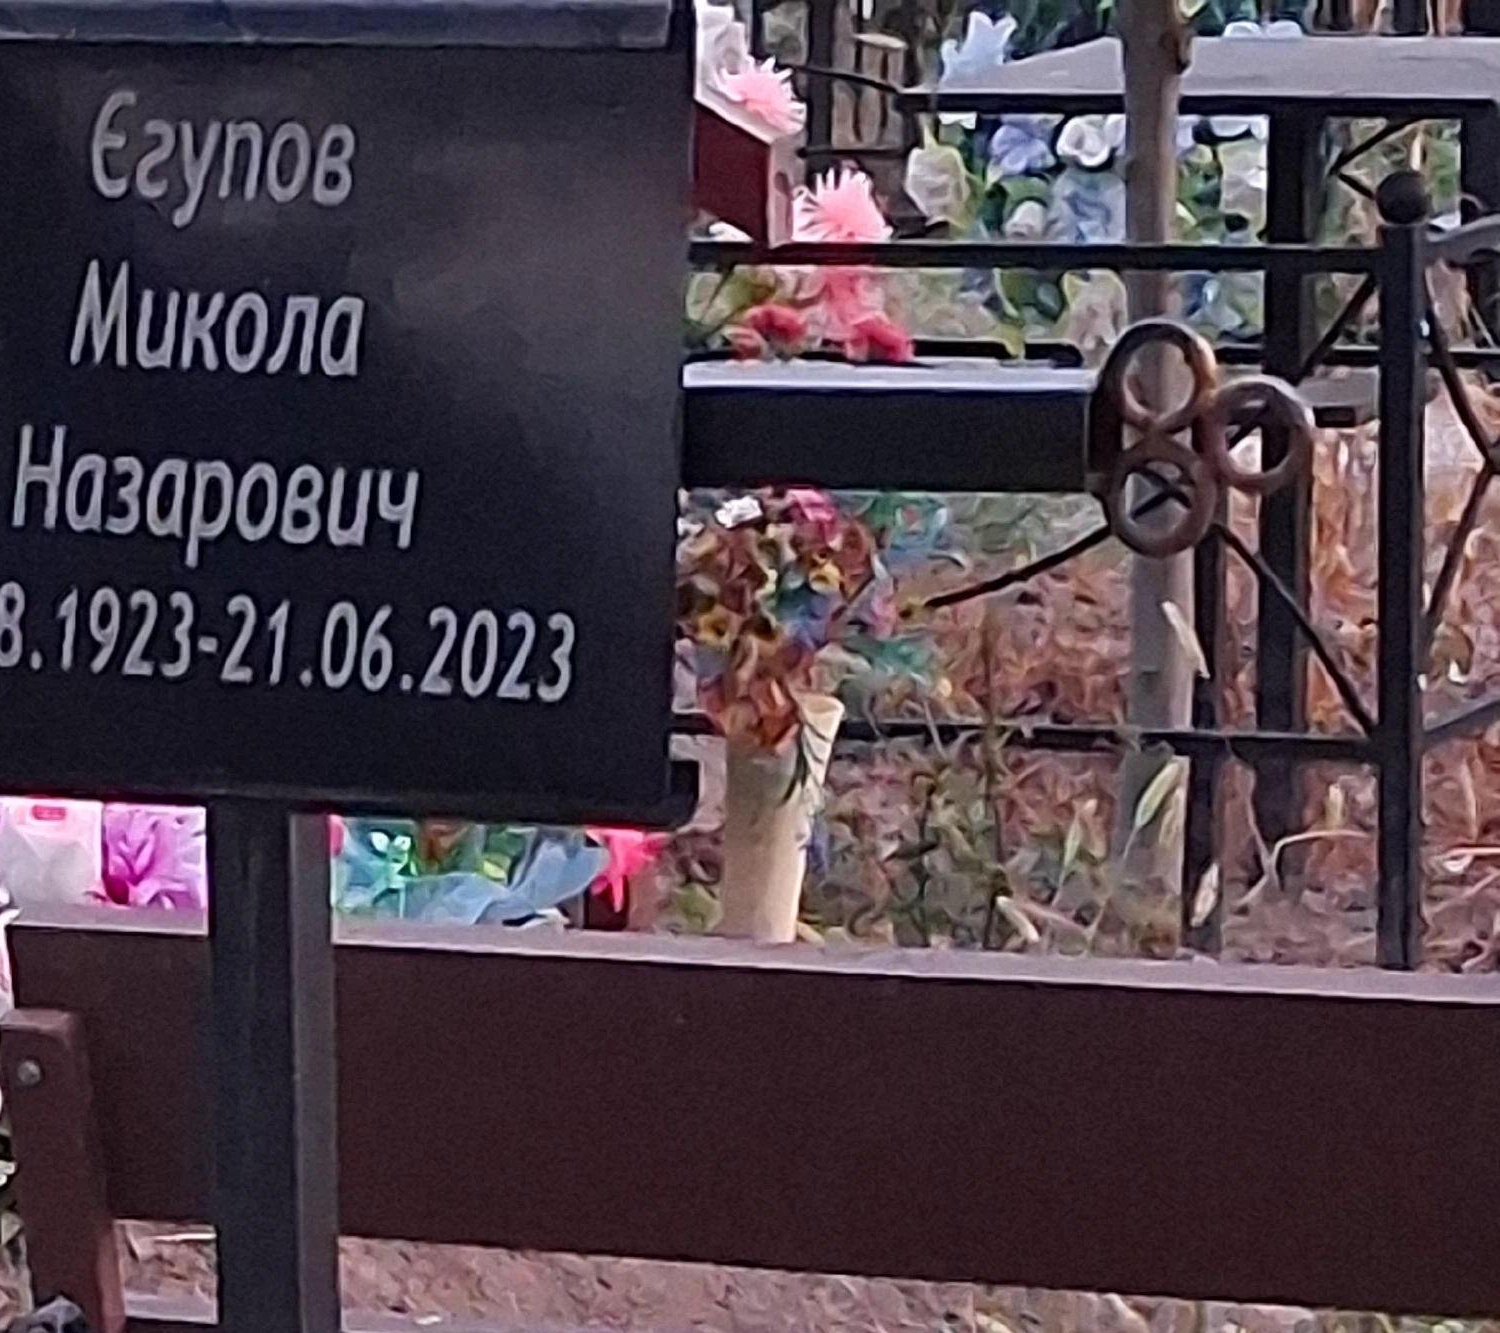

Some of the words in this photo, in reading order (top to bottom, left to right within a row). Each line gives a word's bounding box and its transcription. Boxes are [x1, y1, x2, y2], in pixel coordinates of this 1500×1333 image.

[91, 89, 357, 229] Єгупов
[69, 259, 365, 377] Микола
[12, 424, 420, 568] Назарович
